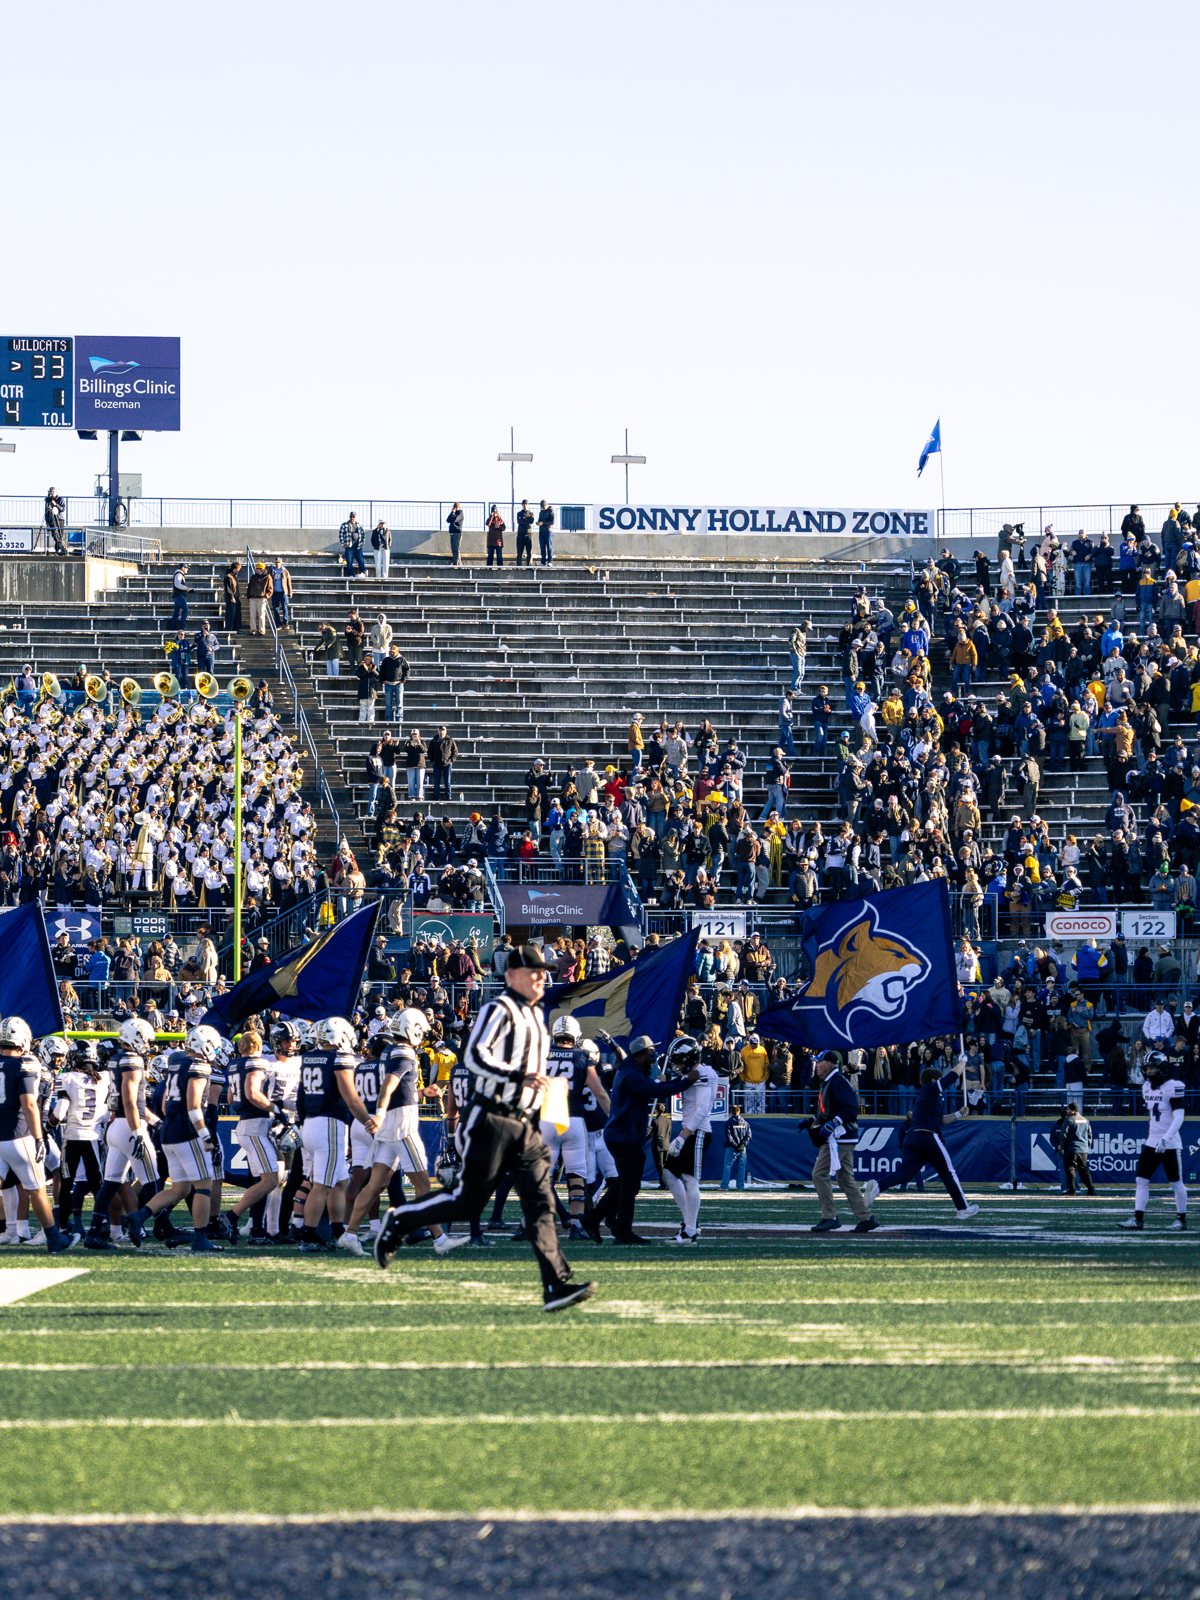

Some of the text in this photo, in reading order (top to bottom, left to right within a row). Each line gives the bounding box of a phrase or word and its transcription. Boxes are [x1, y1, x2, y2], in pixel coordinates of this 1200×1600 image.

[13, 339, 67, 351] WILDCATS
[33, 355, 64, 378] 33
[0, 385, 24, 398] QTR
[80, 378, 176, 398] Billings Clinic
[6, 401, 20, 421] 4
[94, 399, 141, 409] Bozeman
[42, 412, 71, 425] T.O.L.
[599, 507, 928, 534] SONNY HOLLAND ZONE
[413, 882, 424, 894] 14
[521, 905, 583, 917] Billings Clinic
[469, 926, 481, 936] Go
[703, 921, 735, 936] 121
[1131, 921, 1166, 936] 122
[303, 1067, 325, 1095] 92
[1088, 1133, 1146, 1155] uilder
